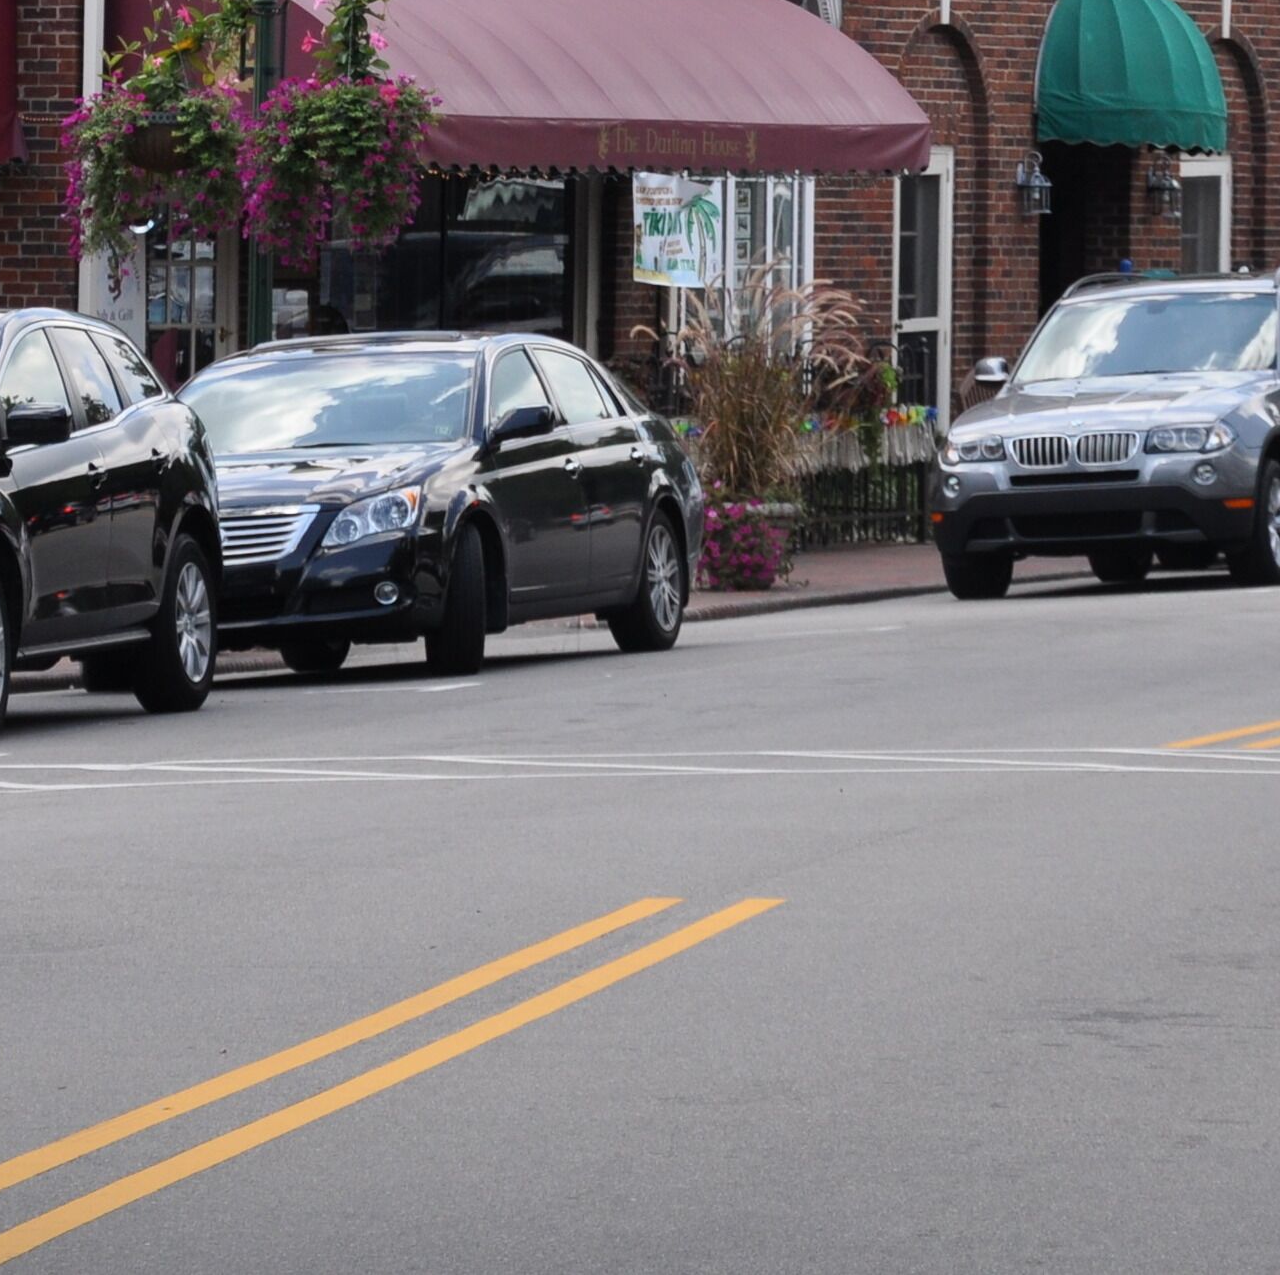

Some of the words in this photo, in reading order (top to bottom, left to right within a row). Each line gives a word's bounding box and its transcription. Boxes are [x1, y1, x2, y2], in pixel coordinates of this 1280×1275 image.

[611, 127, 640, 153] The
[646, 128, 696, 162] Darling
[702, 130, 742, 157] House
